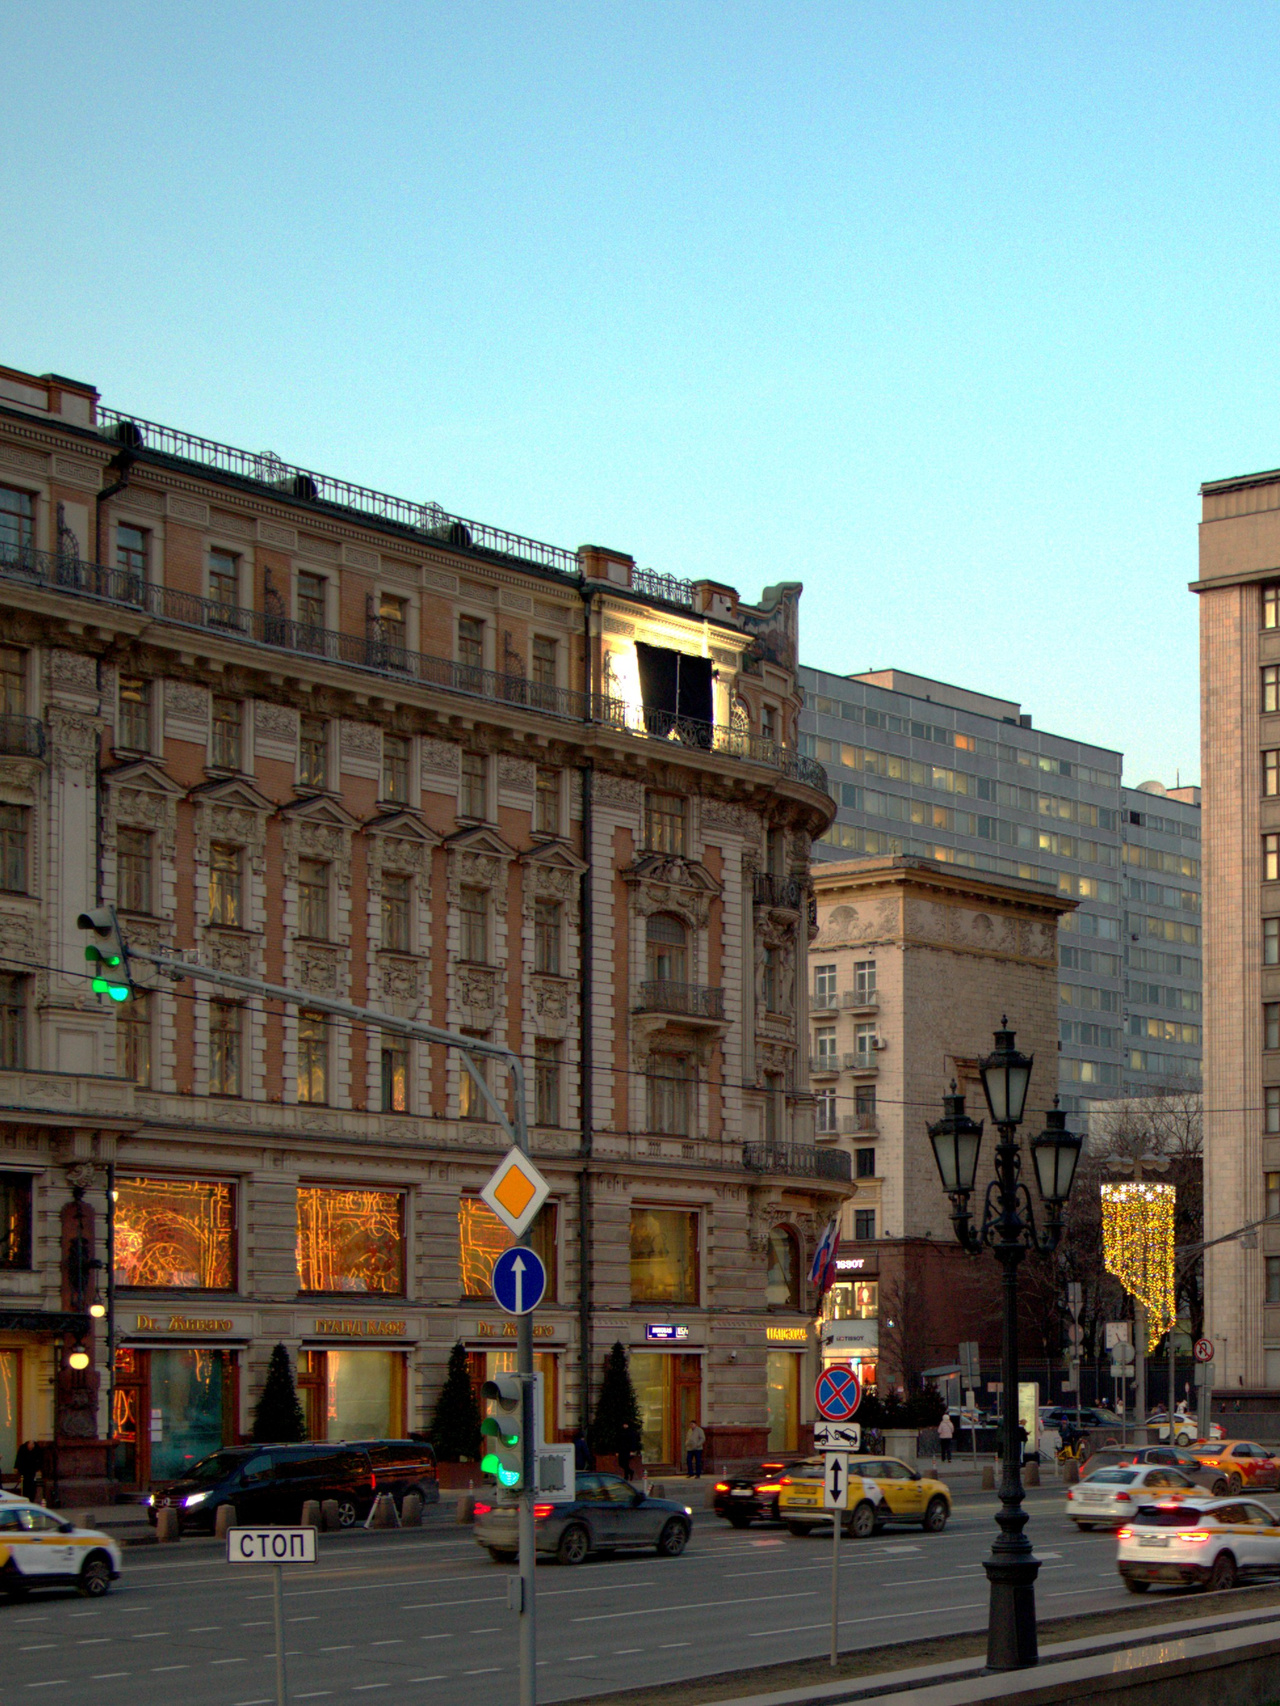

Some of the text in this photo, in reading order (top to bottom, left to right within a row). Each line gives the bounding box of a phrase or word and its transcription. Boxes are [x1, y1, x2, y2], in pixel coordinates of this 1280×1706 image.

[136, 1314, 234, 1332] Dr. Живаго
[315, 1319, 406, 1336] ГРАНД КАФЕ
[477, 1320, 554, 1337] Dr. Жаго
[240, 1533, 304, 1557] СТОП
